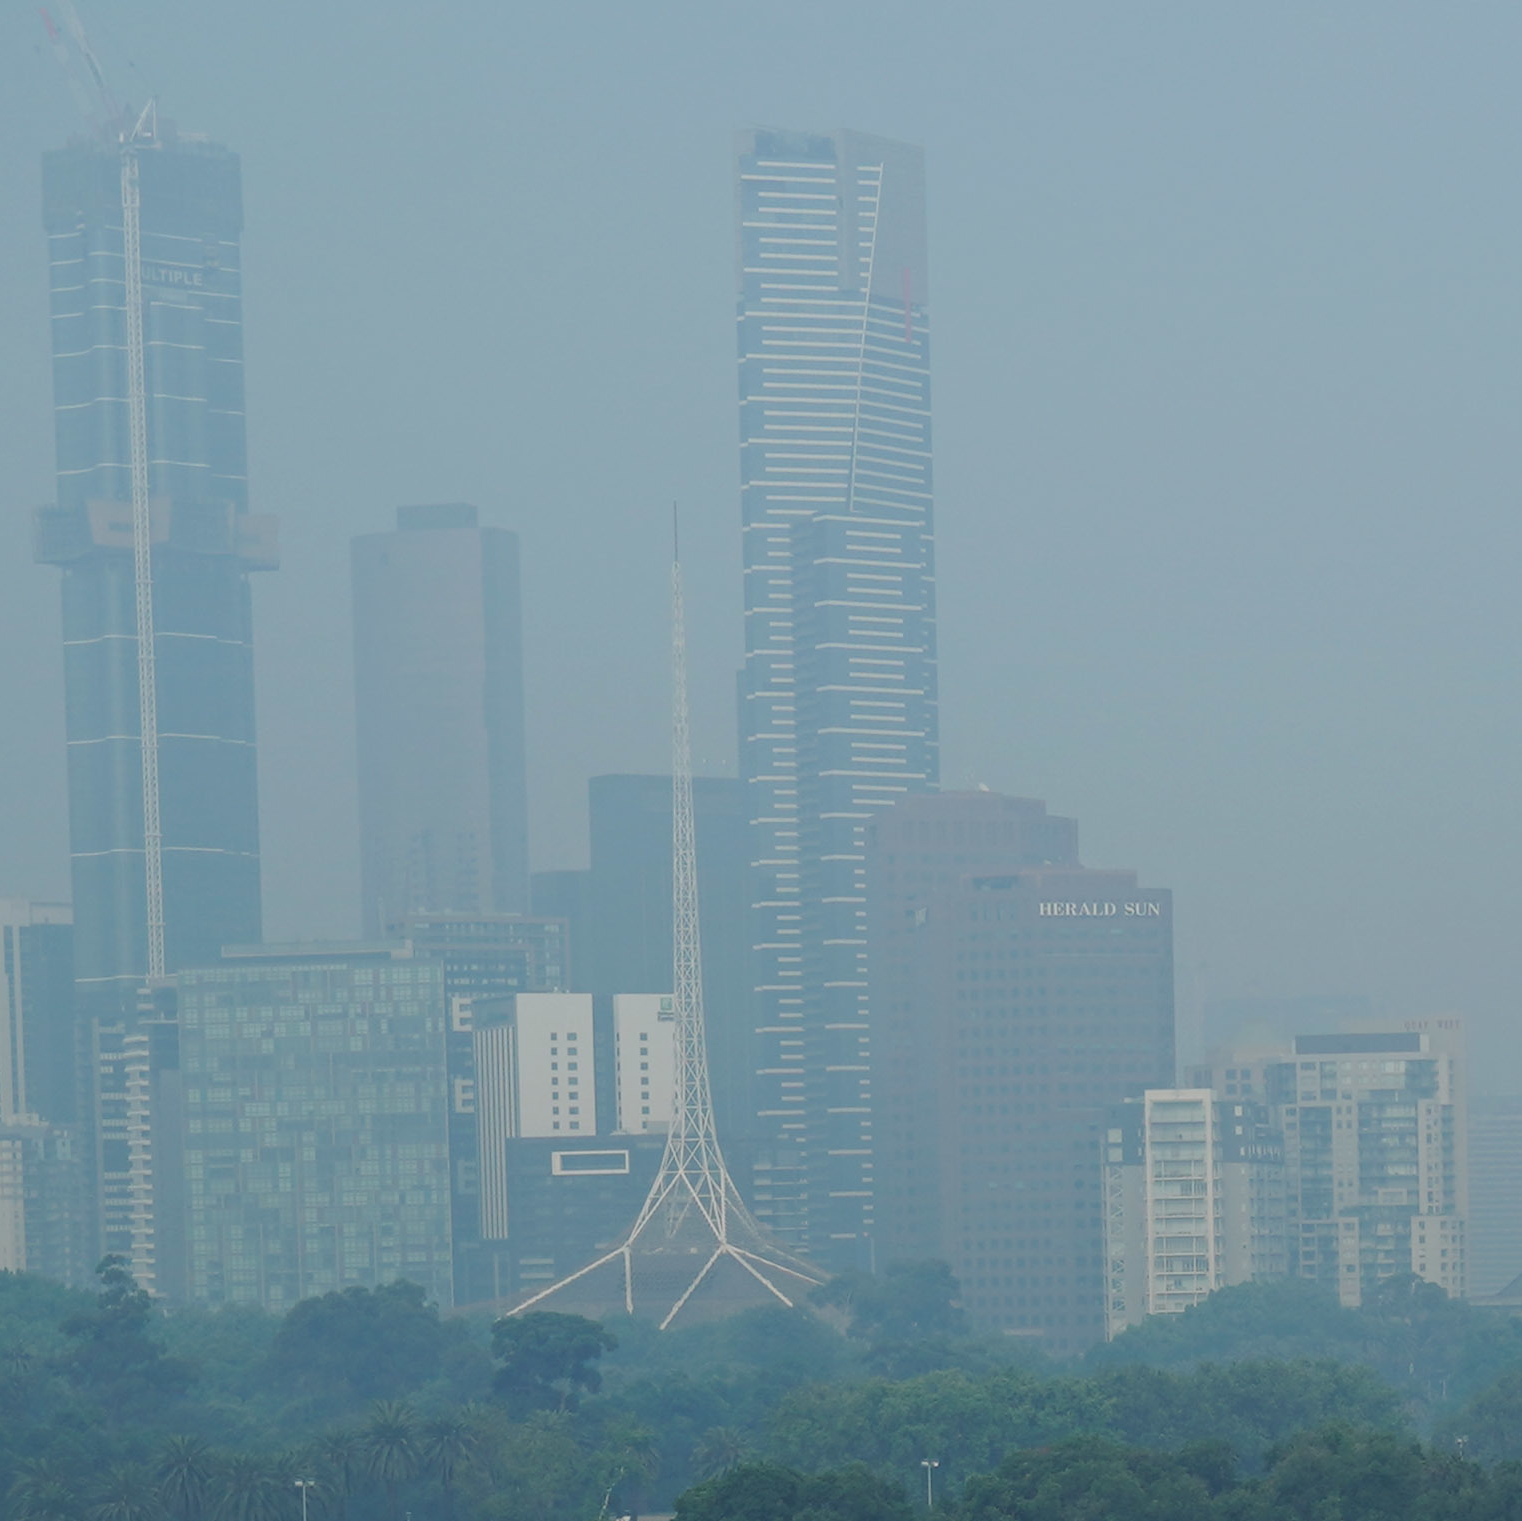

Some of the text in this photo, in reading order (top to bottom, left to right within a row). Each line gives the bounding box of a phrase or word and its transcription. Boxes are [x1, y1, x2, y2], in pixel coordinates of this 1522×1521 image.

[141, 265, 203, 286] ULTIPLE
[1039, 902, 1160, 917] HERALD SUN
